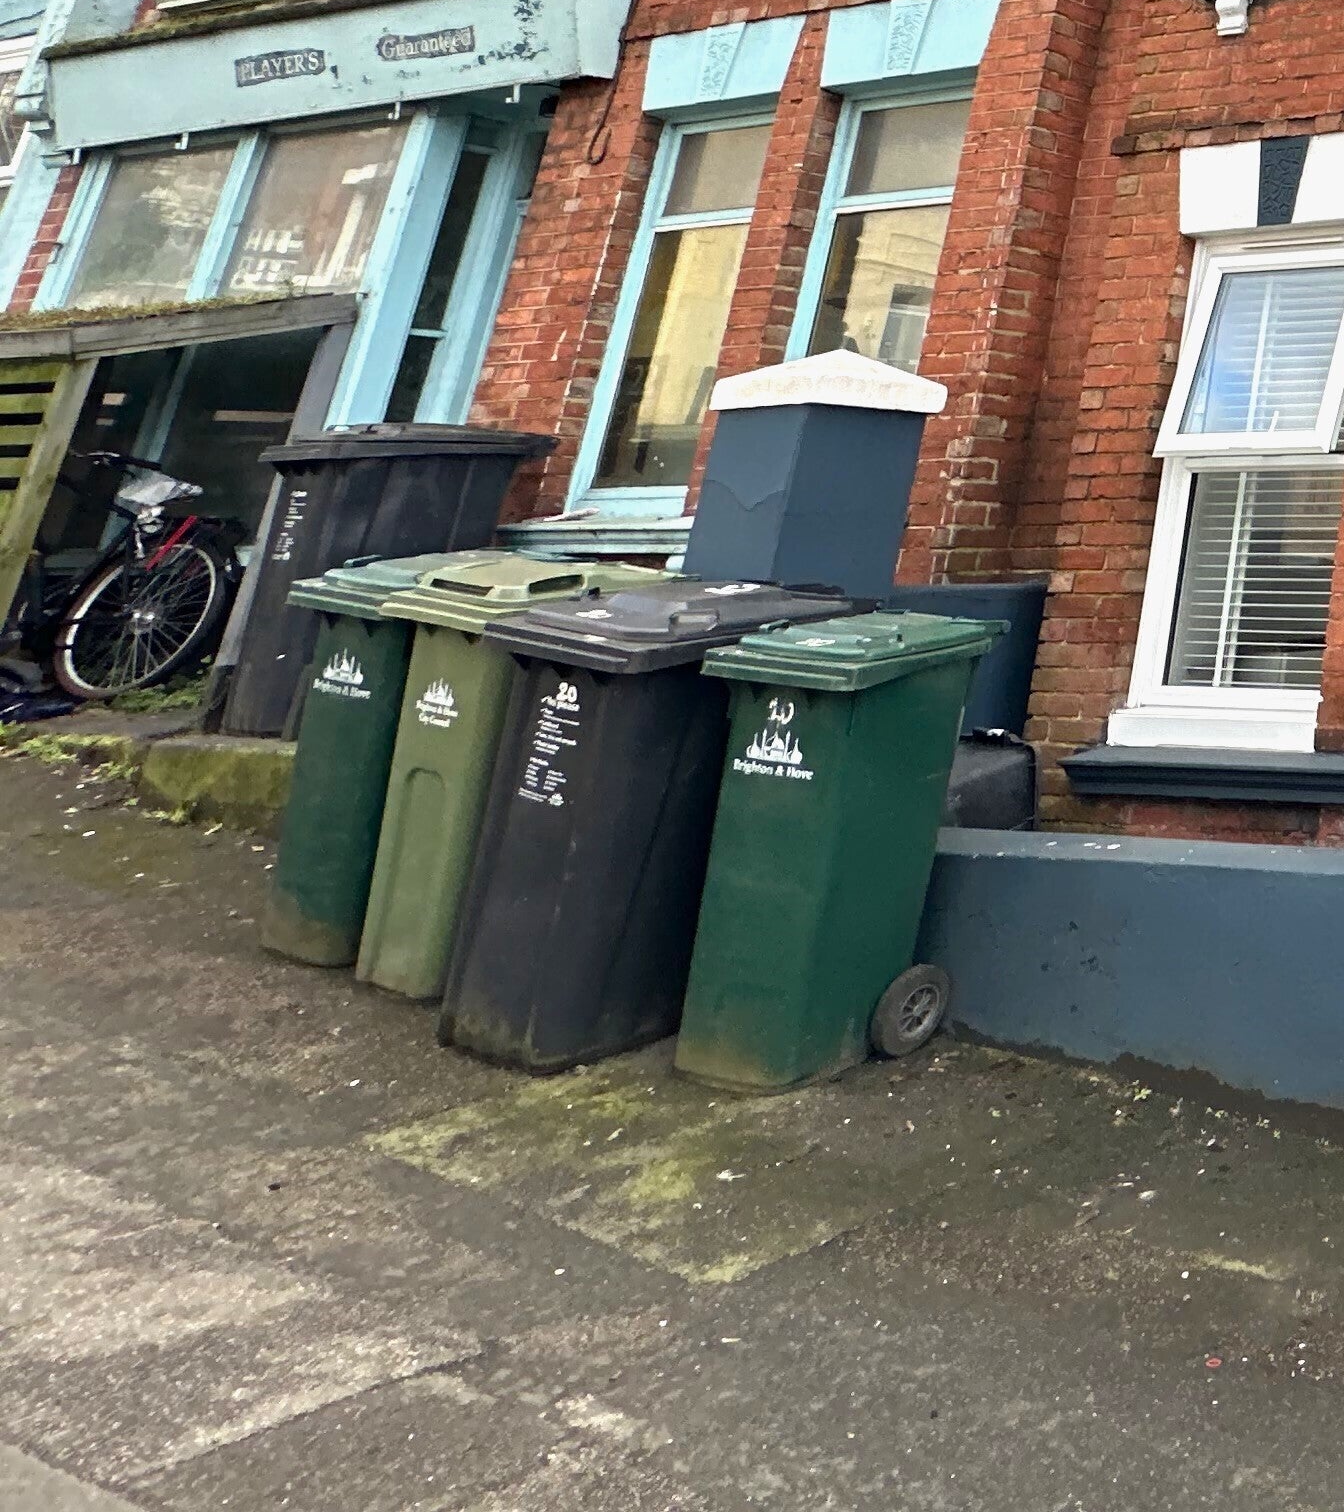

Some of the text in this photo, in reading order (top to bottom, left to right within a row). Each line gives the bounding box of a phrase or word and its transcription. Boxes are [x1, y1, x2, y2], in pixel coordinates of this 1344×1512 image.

[556, 682, 578, 703] 20
[733, 758, 814, 781] Brighton & Hove
